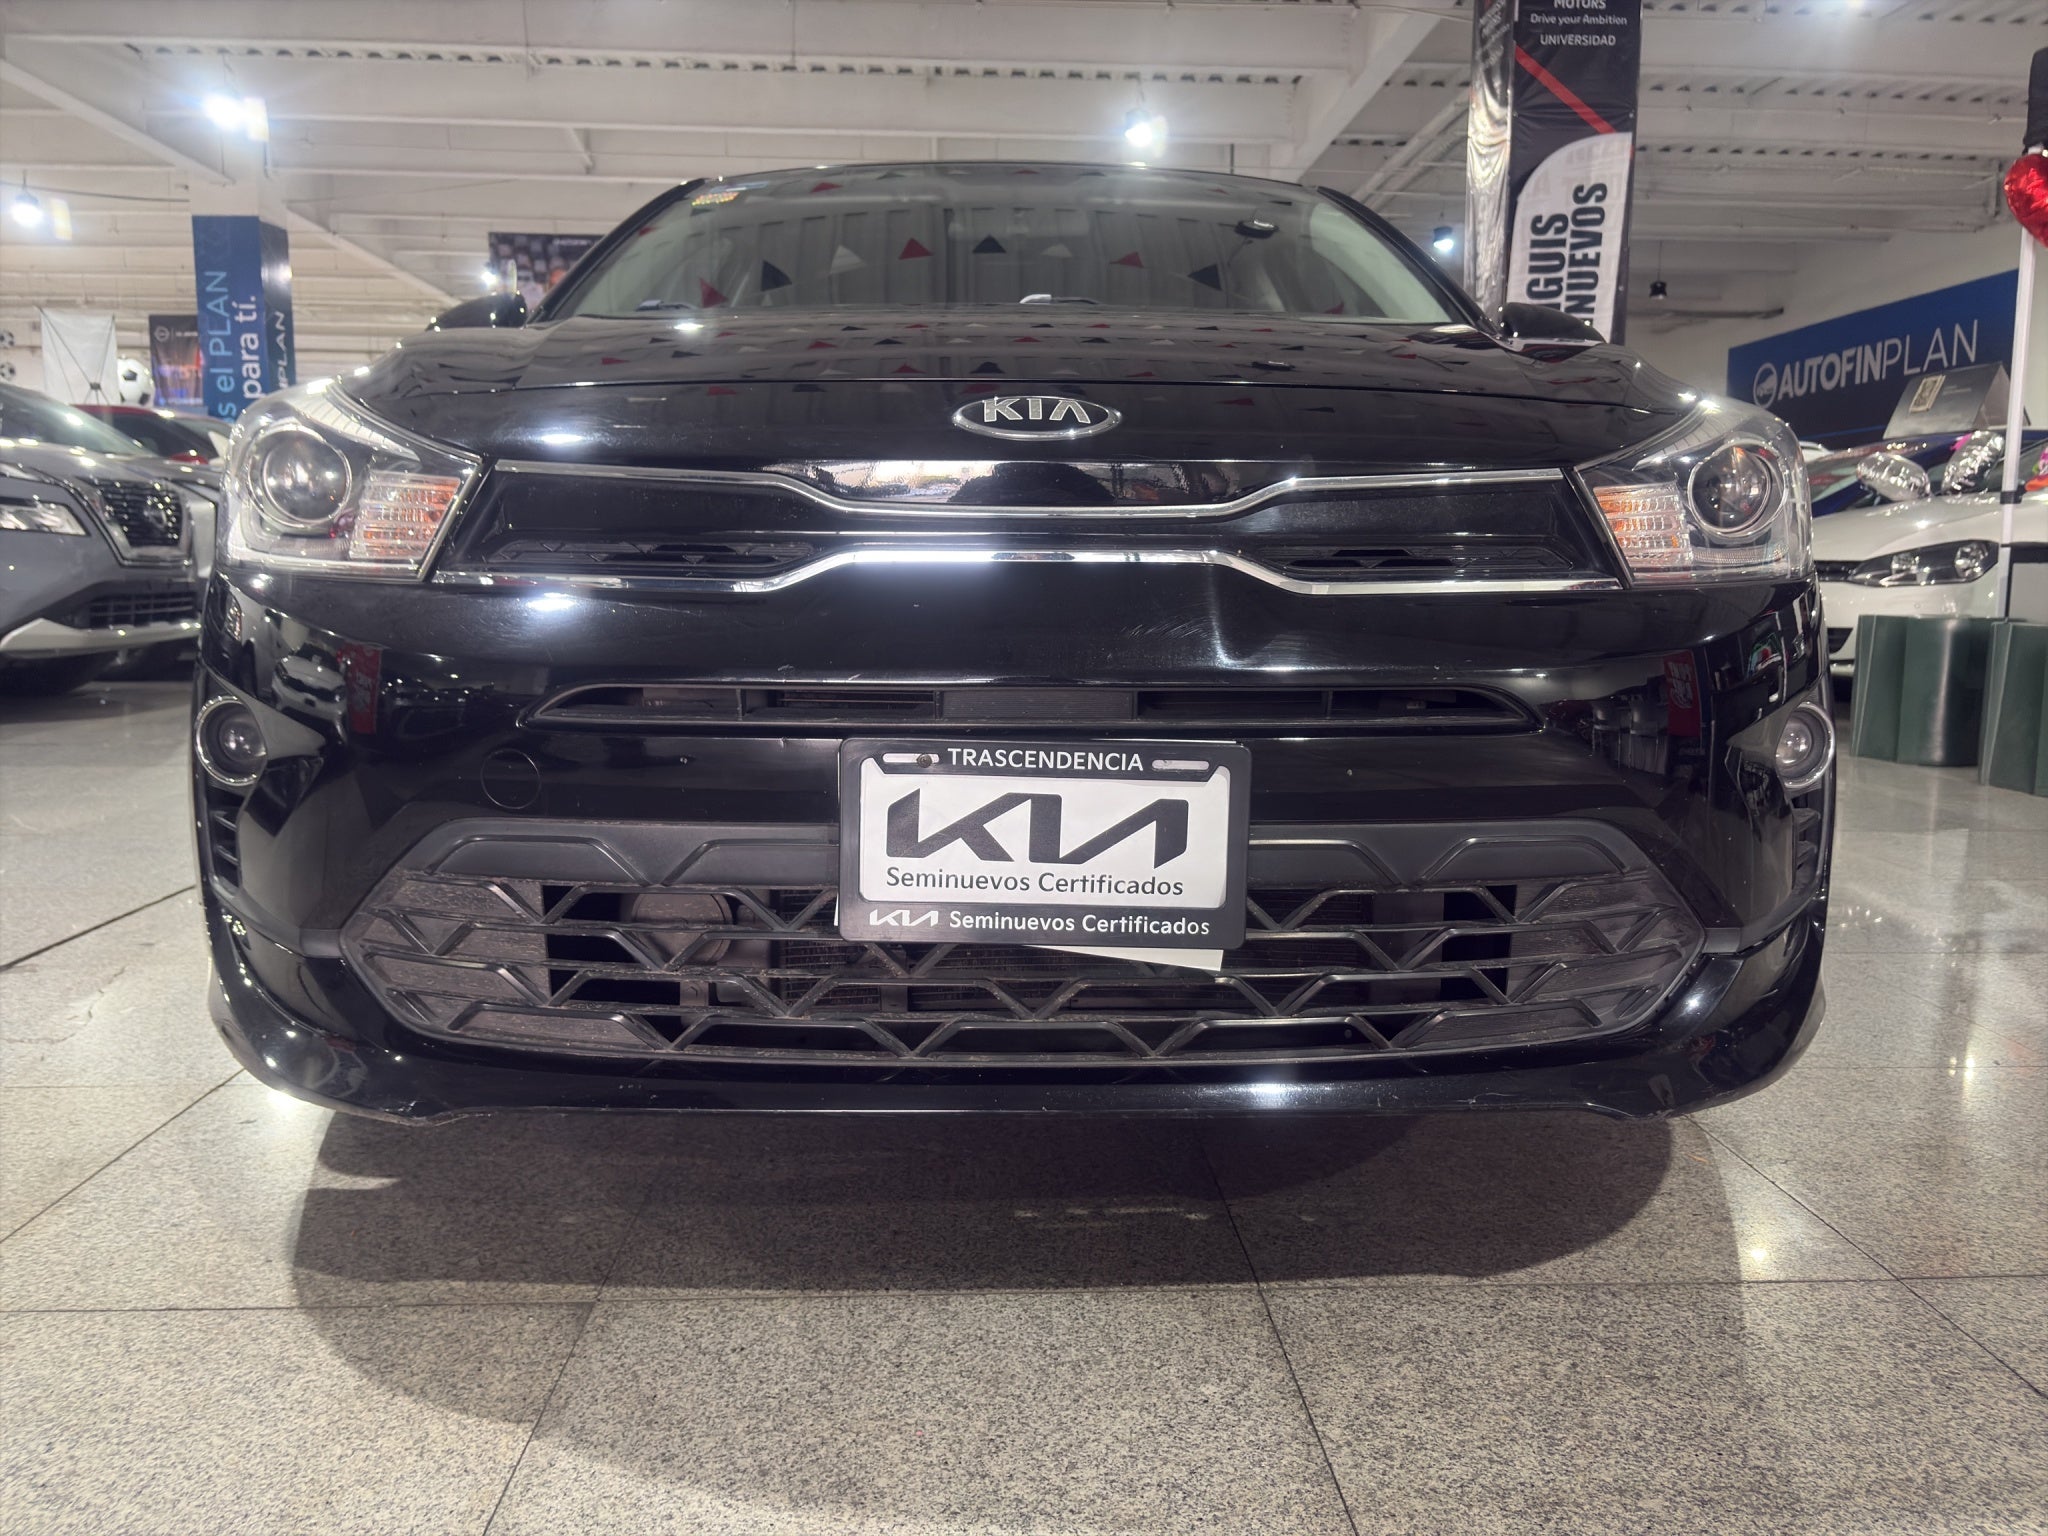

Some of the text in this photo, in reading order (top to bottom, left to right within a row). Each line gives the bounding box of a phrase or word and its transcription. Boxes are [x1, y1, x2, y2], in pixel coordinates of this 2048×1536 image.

[1530, 13, 1628, 26] Drive your Ambition
[1540, 34, 1616, 47] UNIVERSIDAD
[204, 271, 232, 356] PLAN
[240, 333, 262, 399] para
[1778, 319, 1978, 400] AUTOFINPLAN
[210, 368, 234, 393] el
[983, 398, 1091, 424] KIA
[947, 748, 1144, 771] TRASCENDENCIA
[886, 788, 1189, 869] KIA
[886, 866, 1184, 895] Seminuevos Certificados
[869, 909, 1210, 935] KIA Seminuevos Certificados
